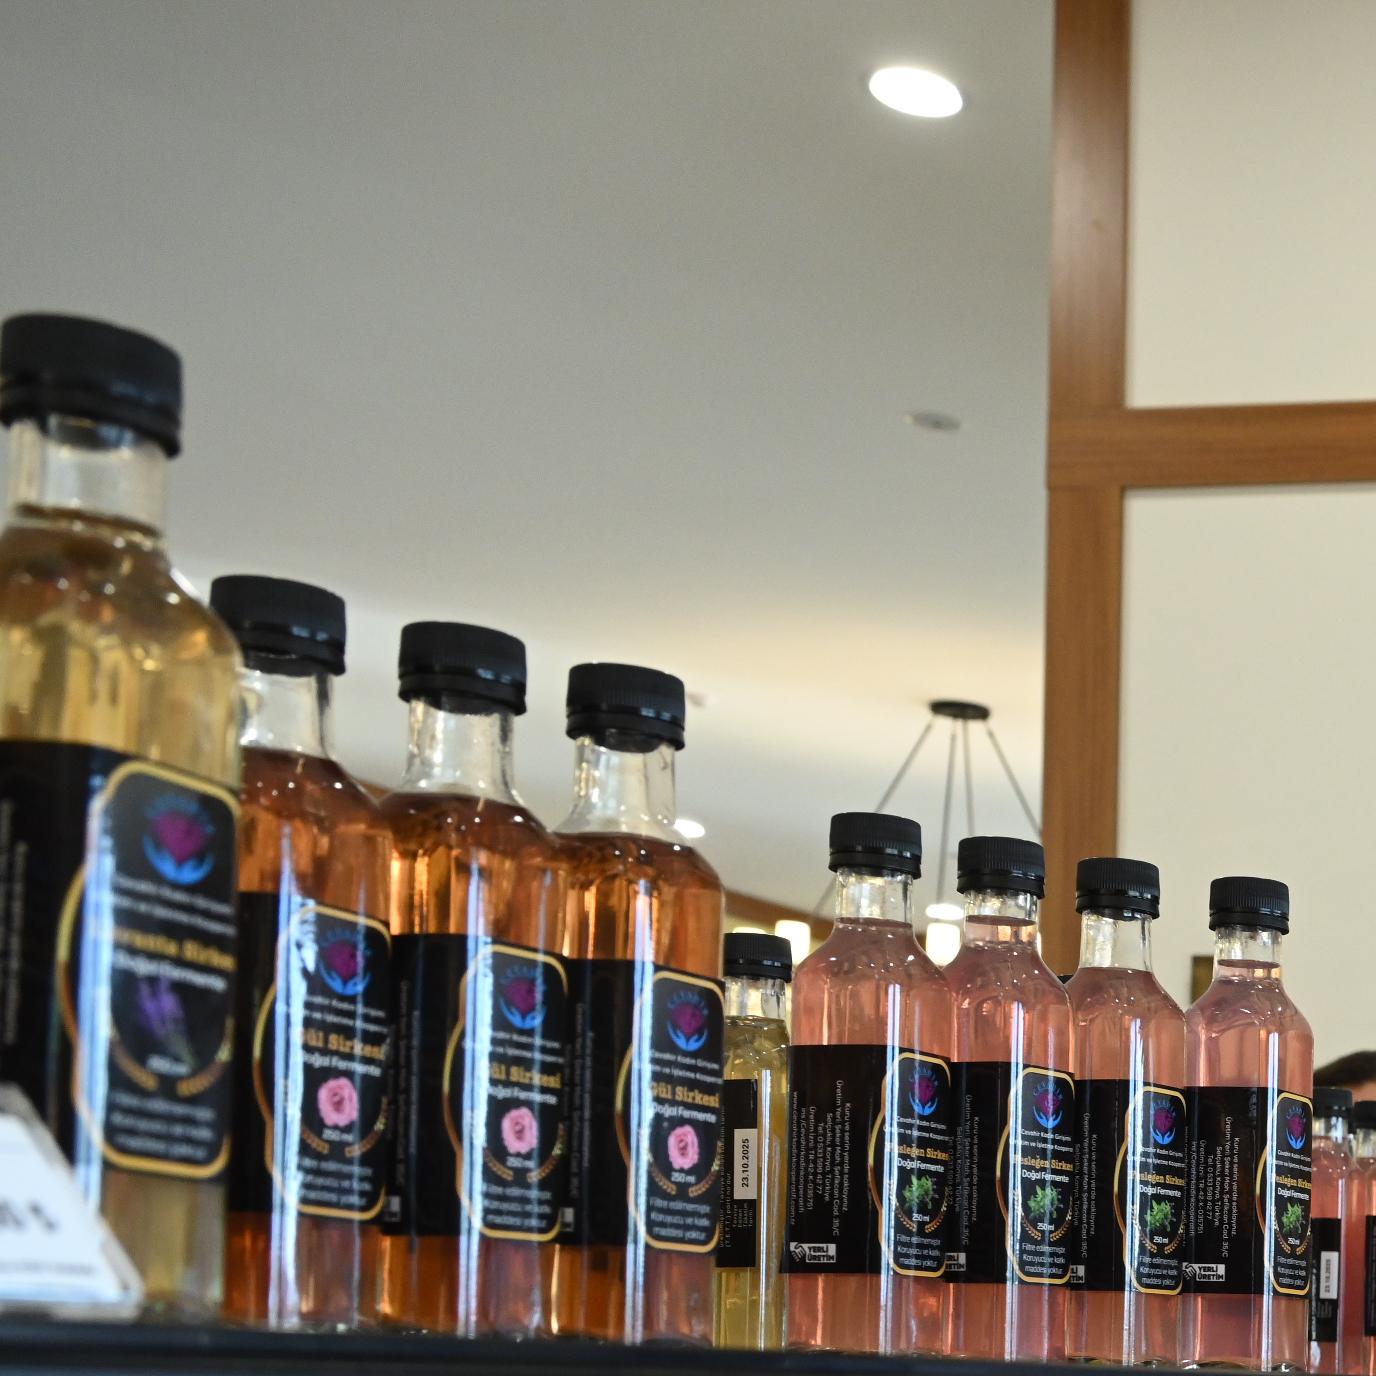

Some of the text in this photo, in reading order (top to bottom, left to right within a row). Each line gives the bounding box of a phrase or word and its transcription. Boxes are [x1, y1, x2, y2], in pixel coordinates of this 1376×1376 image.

[741, 1138, 750, 1188] 23.10.2025
[897, 1157, 945, 1173] Doğal Fermente
[1021, 1168, 1070, 1183] Doğal Fermente
[1139, 1184, 1182, 1198] Doğal Fermente
[912, 1213, 923, 1222] 250
[1037, 1222, 1048, 1231] 250
[1153, 1235, 1163, 1243] 250
[806, 1244, 829, 1254] YERLİ
[805, 1252, 836, 1262] ÜRETİM
[1198, 1264, 1218, 1273] YERLİ
[1197, 1272, 1224, 1280] ÜRETİM
